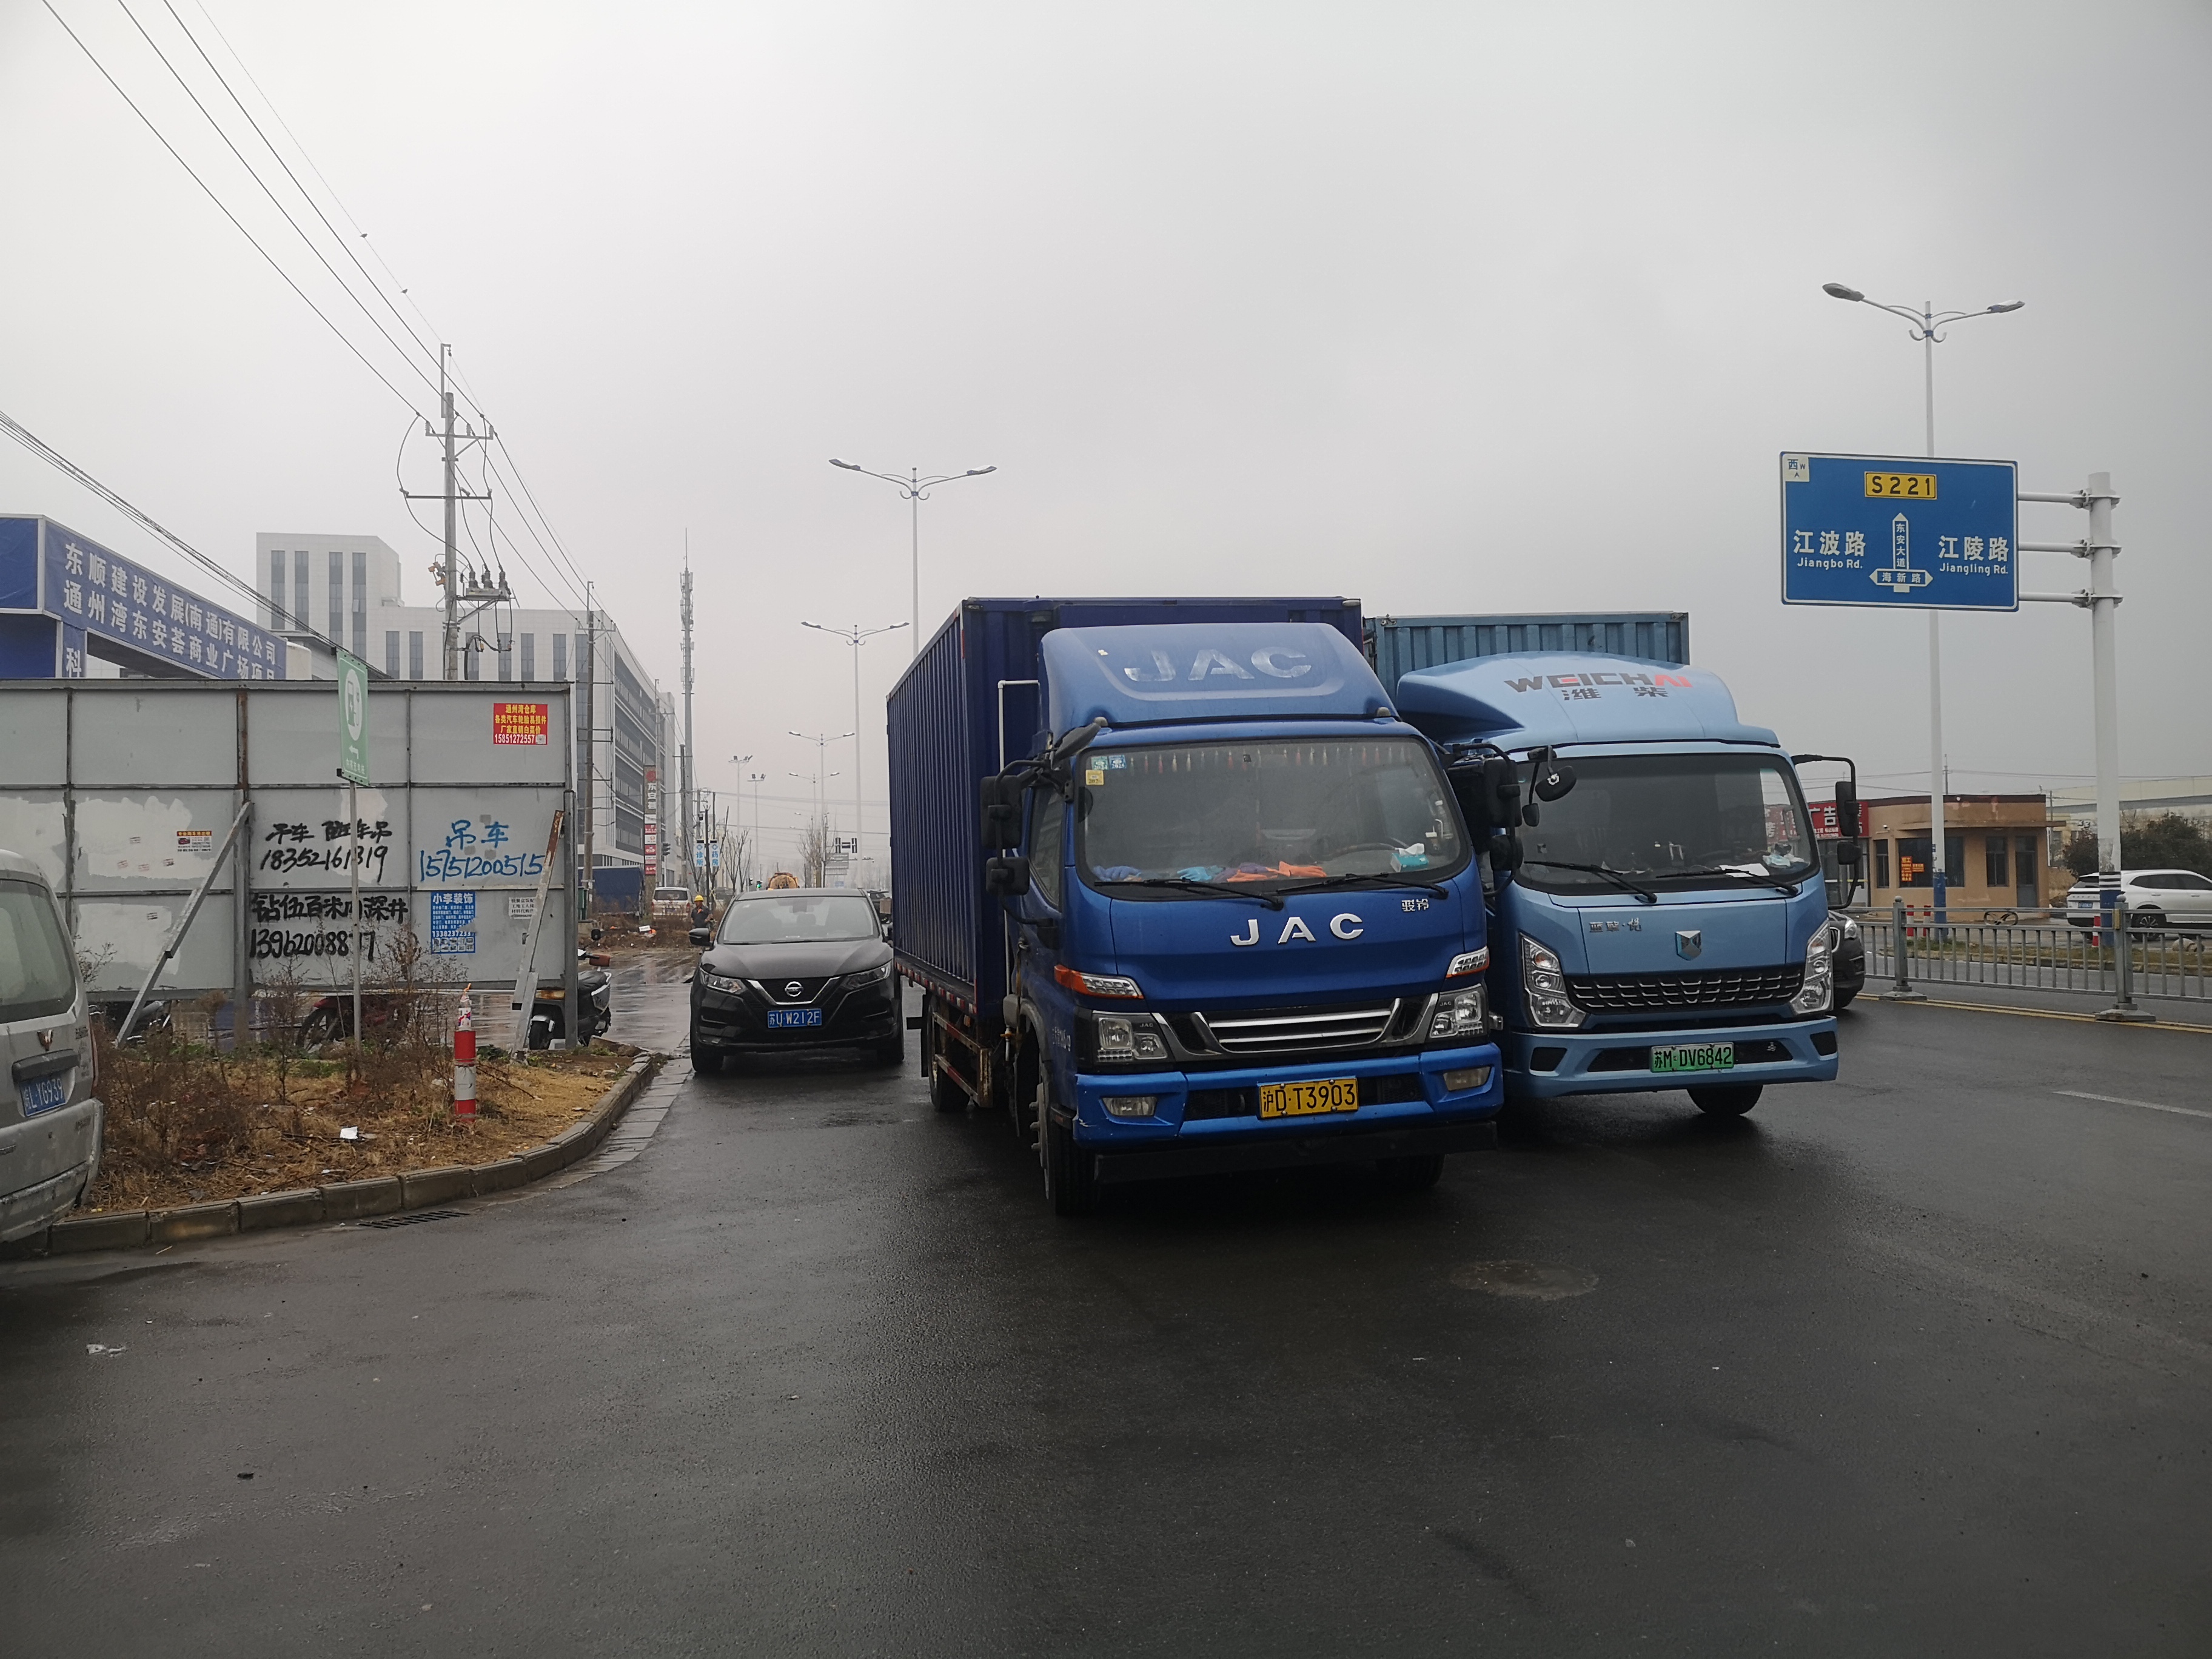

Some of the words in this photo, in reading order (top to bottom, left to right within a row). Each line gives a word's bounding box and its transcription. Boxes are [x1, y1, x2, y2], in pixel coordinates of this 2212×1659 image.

[1788, 458, 1798, 470] 西
[1872, 475, 1931, 495] S221
[1793, 529, 1866, 557] 江波路
[1895, 523, 1906, 568] 东安大道
[1939, 535, 2009, 561] 江陵路
[1797, 557, 1843, 571] Jiangbo
[1846, 558, 1863, 569] Rd.
[1939, 563, 1991, 576] Jiangling
[1994, 564, 2008, 574] Rd.
[1882, 572, 1922, 583] 海新路
[66, 648, 81, 678] 科
[1124, 646, 1312, 682] JAC
[1503, 672, 1693, 692] WEICHAI
[1561, 686, 1669, 701] 潍柴
[505, 704, 537, 714] 通州湾仓库
[495, 734, 535, 743] 15851272557
[446, 820, 509, 850] 吊车
[420, 849, 546, 882] 15751200515
[432, 893, 474, 904] 小李装饰
[1401, 898, 1429, 912] 骏铃
[1230, 913, 1364, 946] JAC
